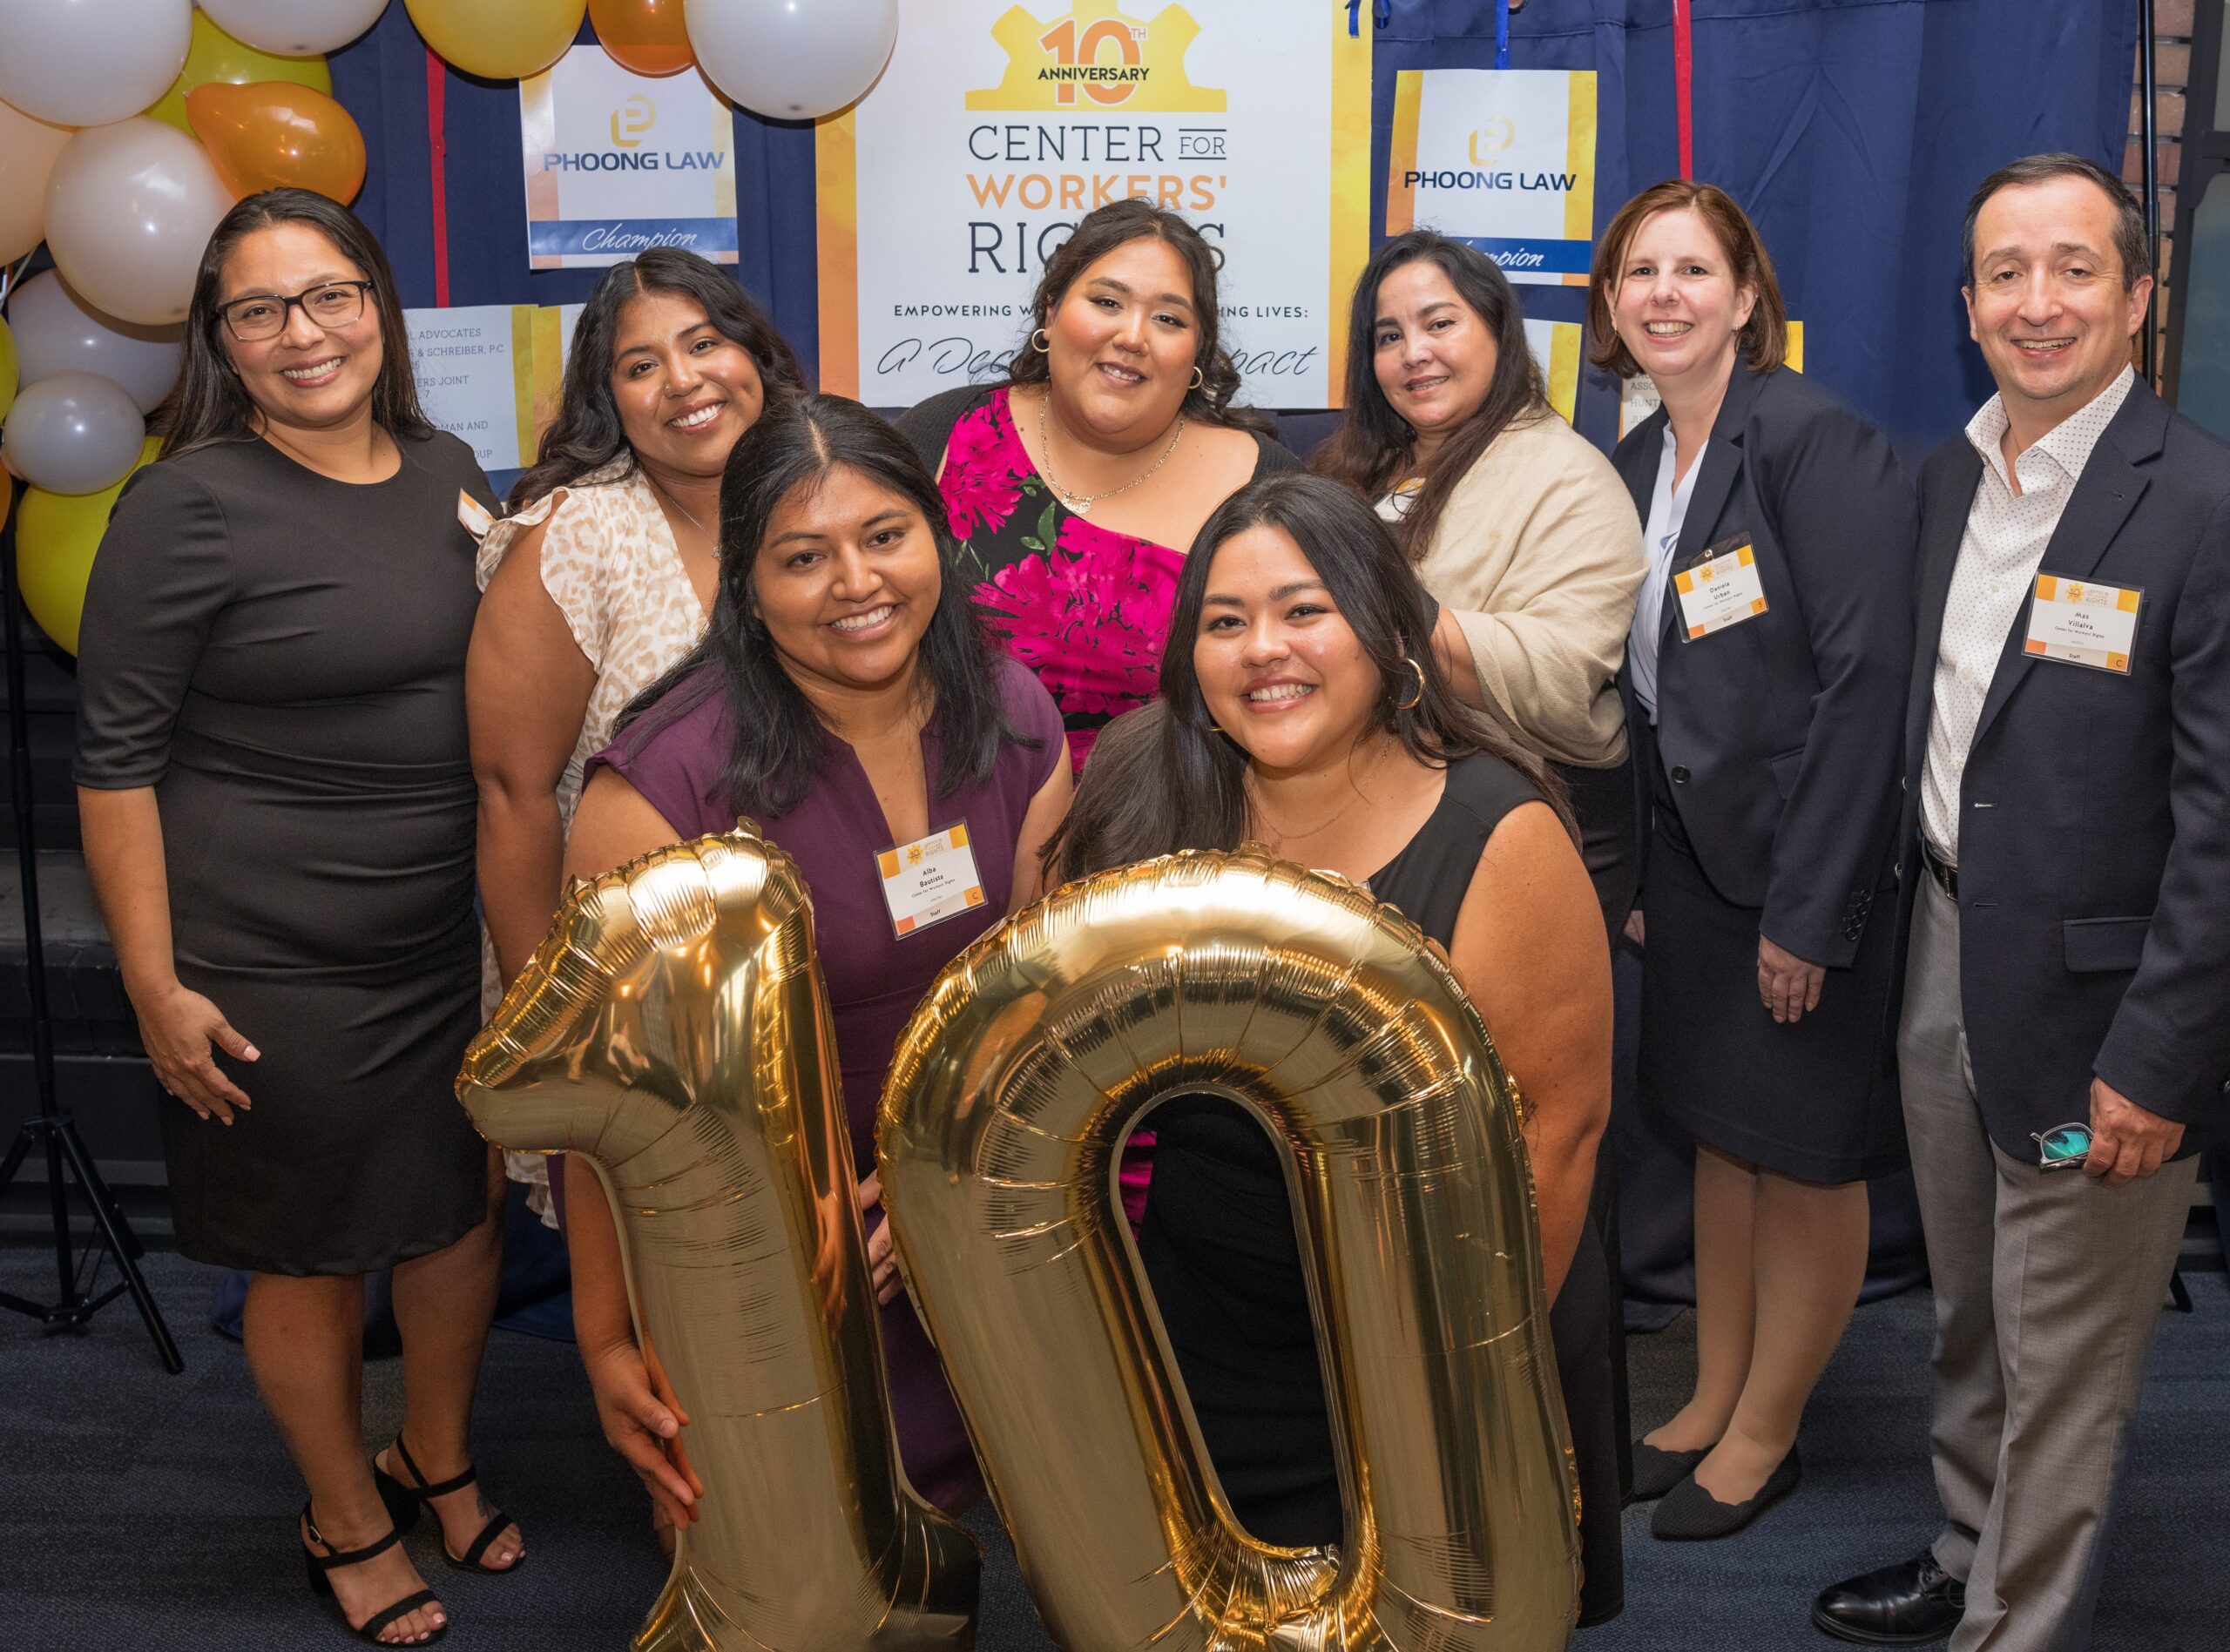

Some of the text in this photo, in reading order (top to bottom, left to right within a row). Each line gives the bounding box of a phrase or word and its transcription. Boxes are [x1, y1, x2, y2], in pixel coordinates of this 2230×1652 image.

[1037, 67, 1150, 81] ANNIVERSARY
[969, 125, 1226, 161] CENTER FOR
[544, 152, 725, 171] PHOONG LAW
[1404, 171, 1577, 191] PHOONG LAW
[582, 223, 698, 250] Champion
[895, 305, 1011, 316] EMPOWERING
[1256, 307, 1308, 317] LIVES:
[418, 328, 481, 340] ADVOCATES
[1231, 347, 1320, 374] pact
[439, 375, 468, 386] JOINT
[467, 421, 489, 430] AND
[922, 867, 936, 876] Alba
[919, 874, 943, 887] Bautista
